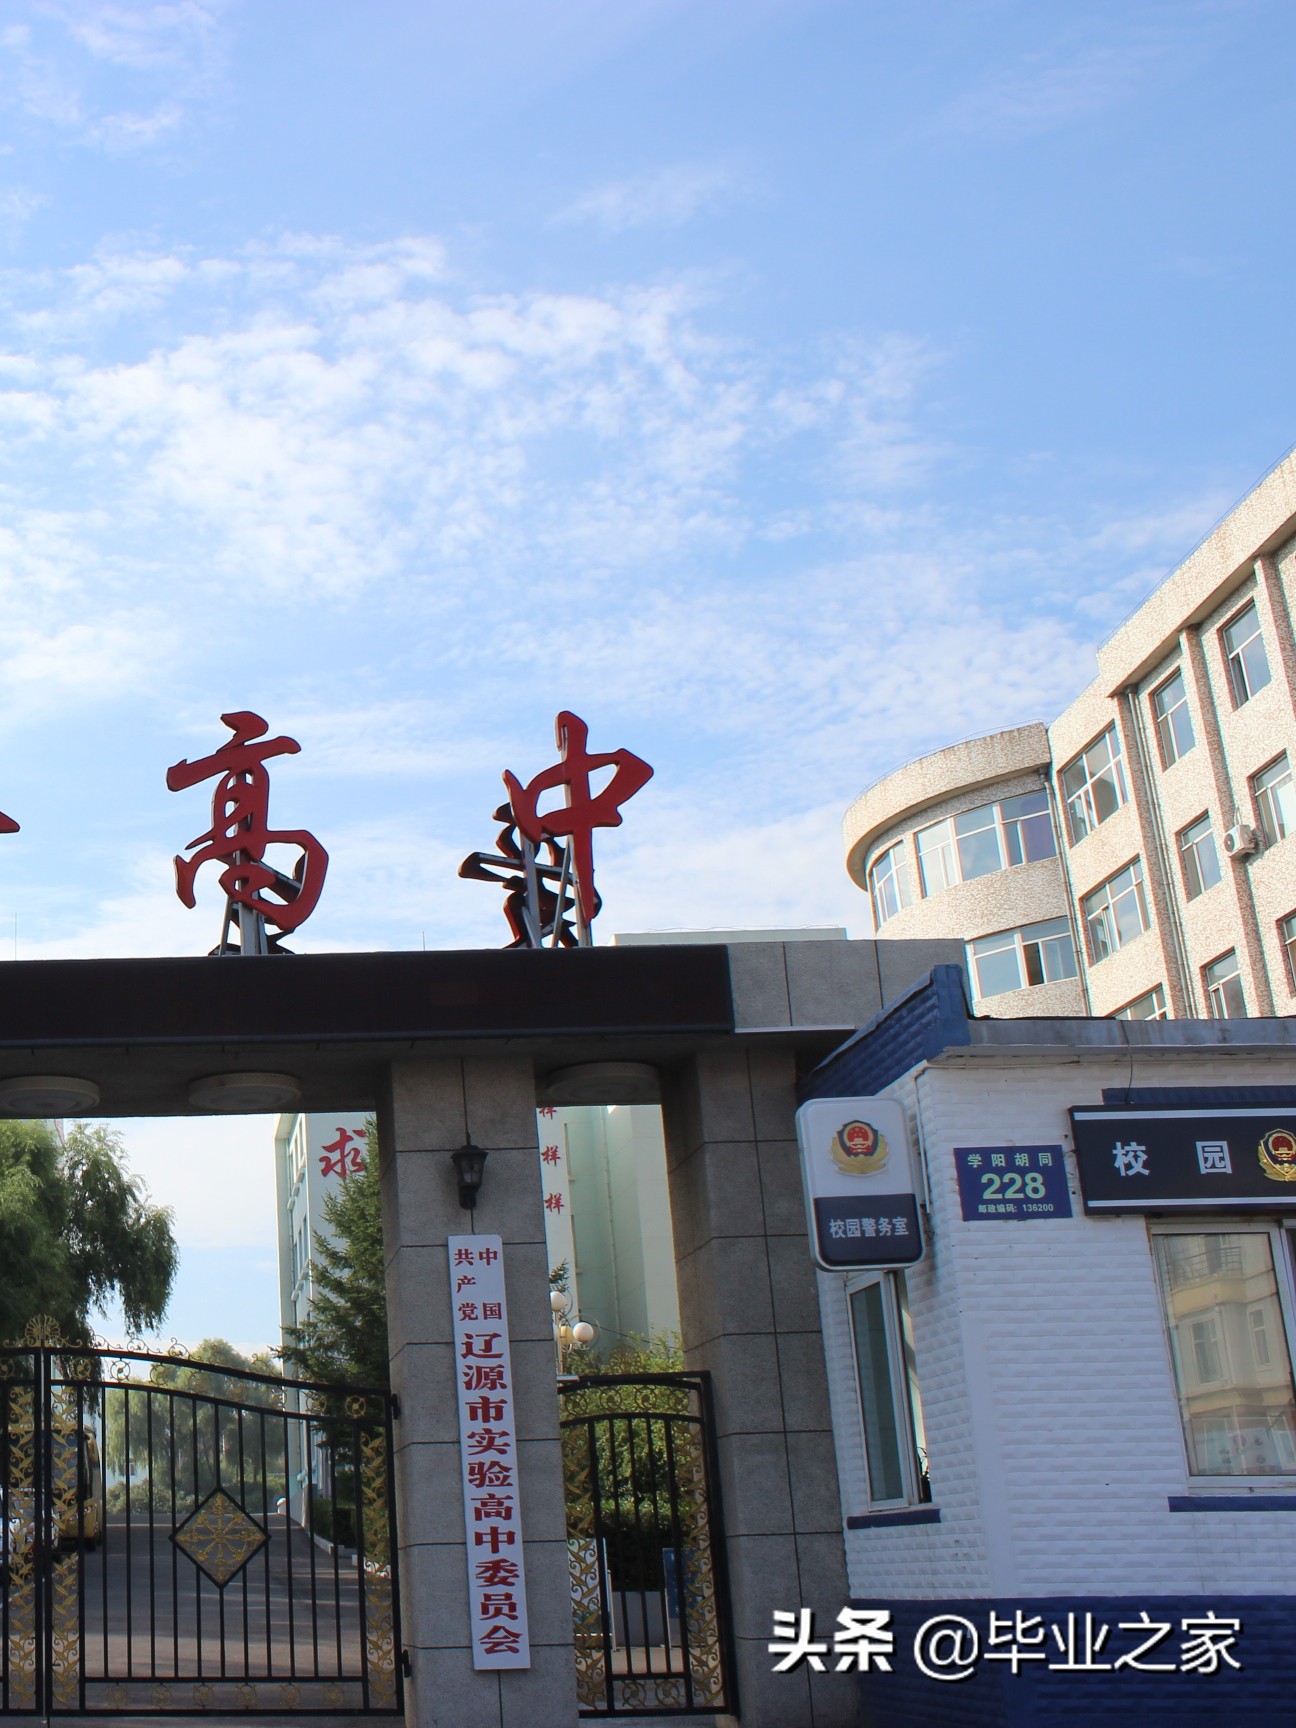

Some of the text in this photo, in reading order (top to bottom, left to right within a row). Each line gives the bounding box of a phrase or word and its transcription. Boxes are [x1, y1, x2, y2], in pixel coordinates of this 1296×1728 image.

[1112, 1140, 1233, 1177] 校园
[980, 1172, 1046, 1199] 228
[1022, 1203, 1054, 1212] 136200
[829, 1216, 909, 1239] 校园警务室
